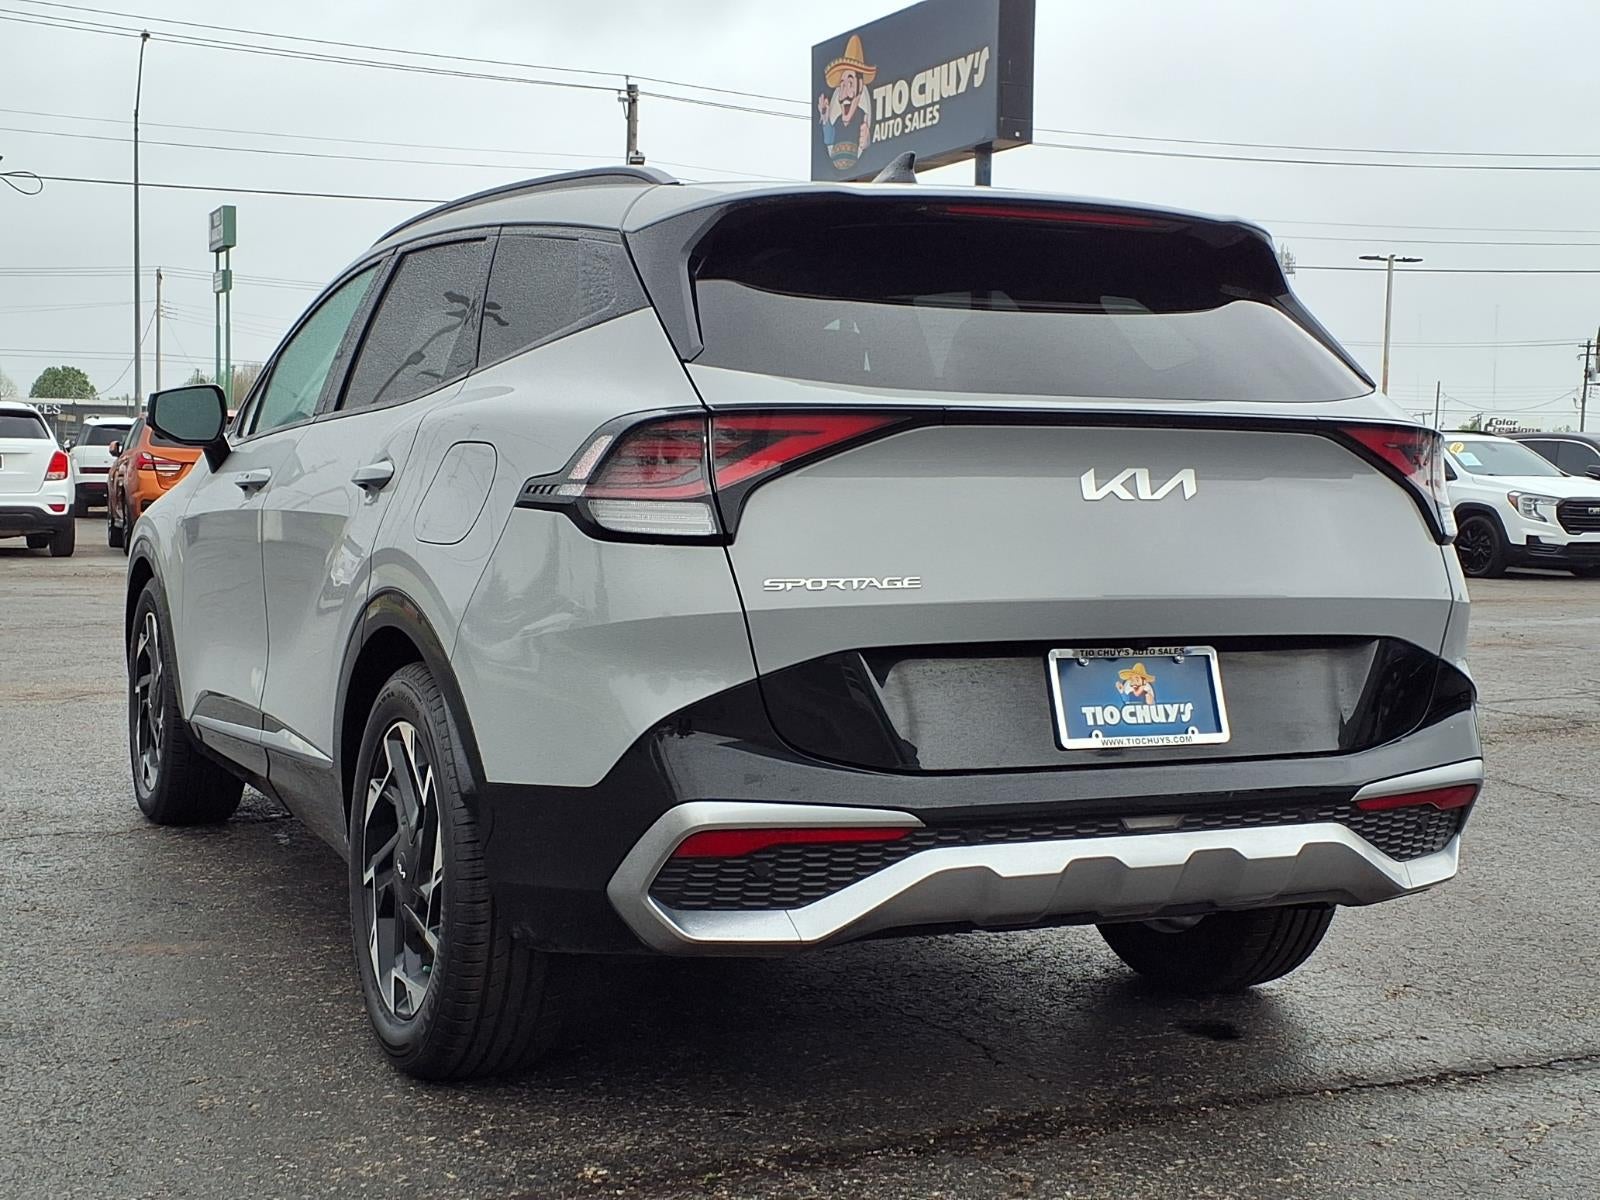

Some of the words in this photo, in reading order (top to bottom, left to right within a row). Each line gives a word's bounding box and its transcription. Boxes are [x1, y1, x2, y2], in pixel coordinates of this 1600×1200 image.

[873, 79, 909, 120] TIO
[911, 46, 990, 108] CHUY'S
[872, 117, 902, 143] AUTO
[904, 104, 940, 133] SALES
[1488, 417, 1519, 426] Color
[763, 576, 922, 592] SPORTAGE
[1097, 648, 1130, 657] CHUY'S
[1132, 648, 1156, 656] AUTO
[1157, 647, 1185, 655] SALES
[1081, 705, 1121, 726] TIO
[1121, 702, 1194, 724] CHUY'S
[1101, 735, 1193, 746] WWW.TIOCHUYS.COM
